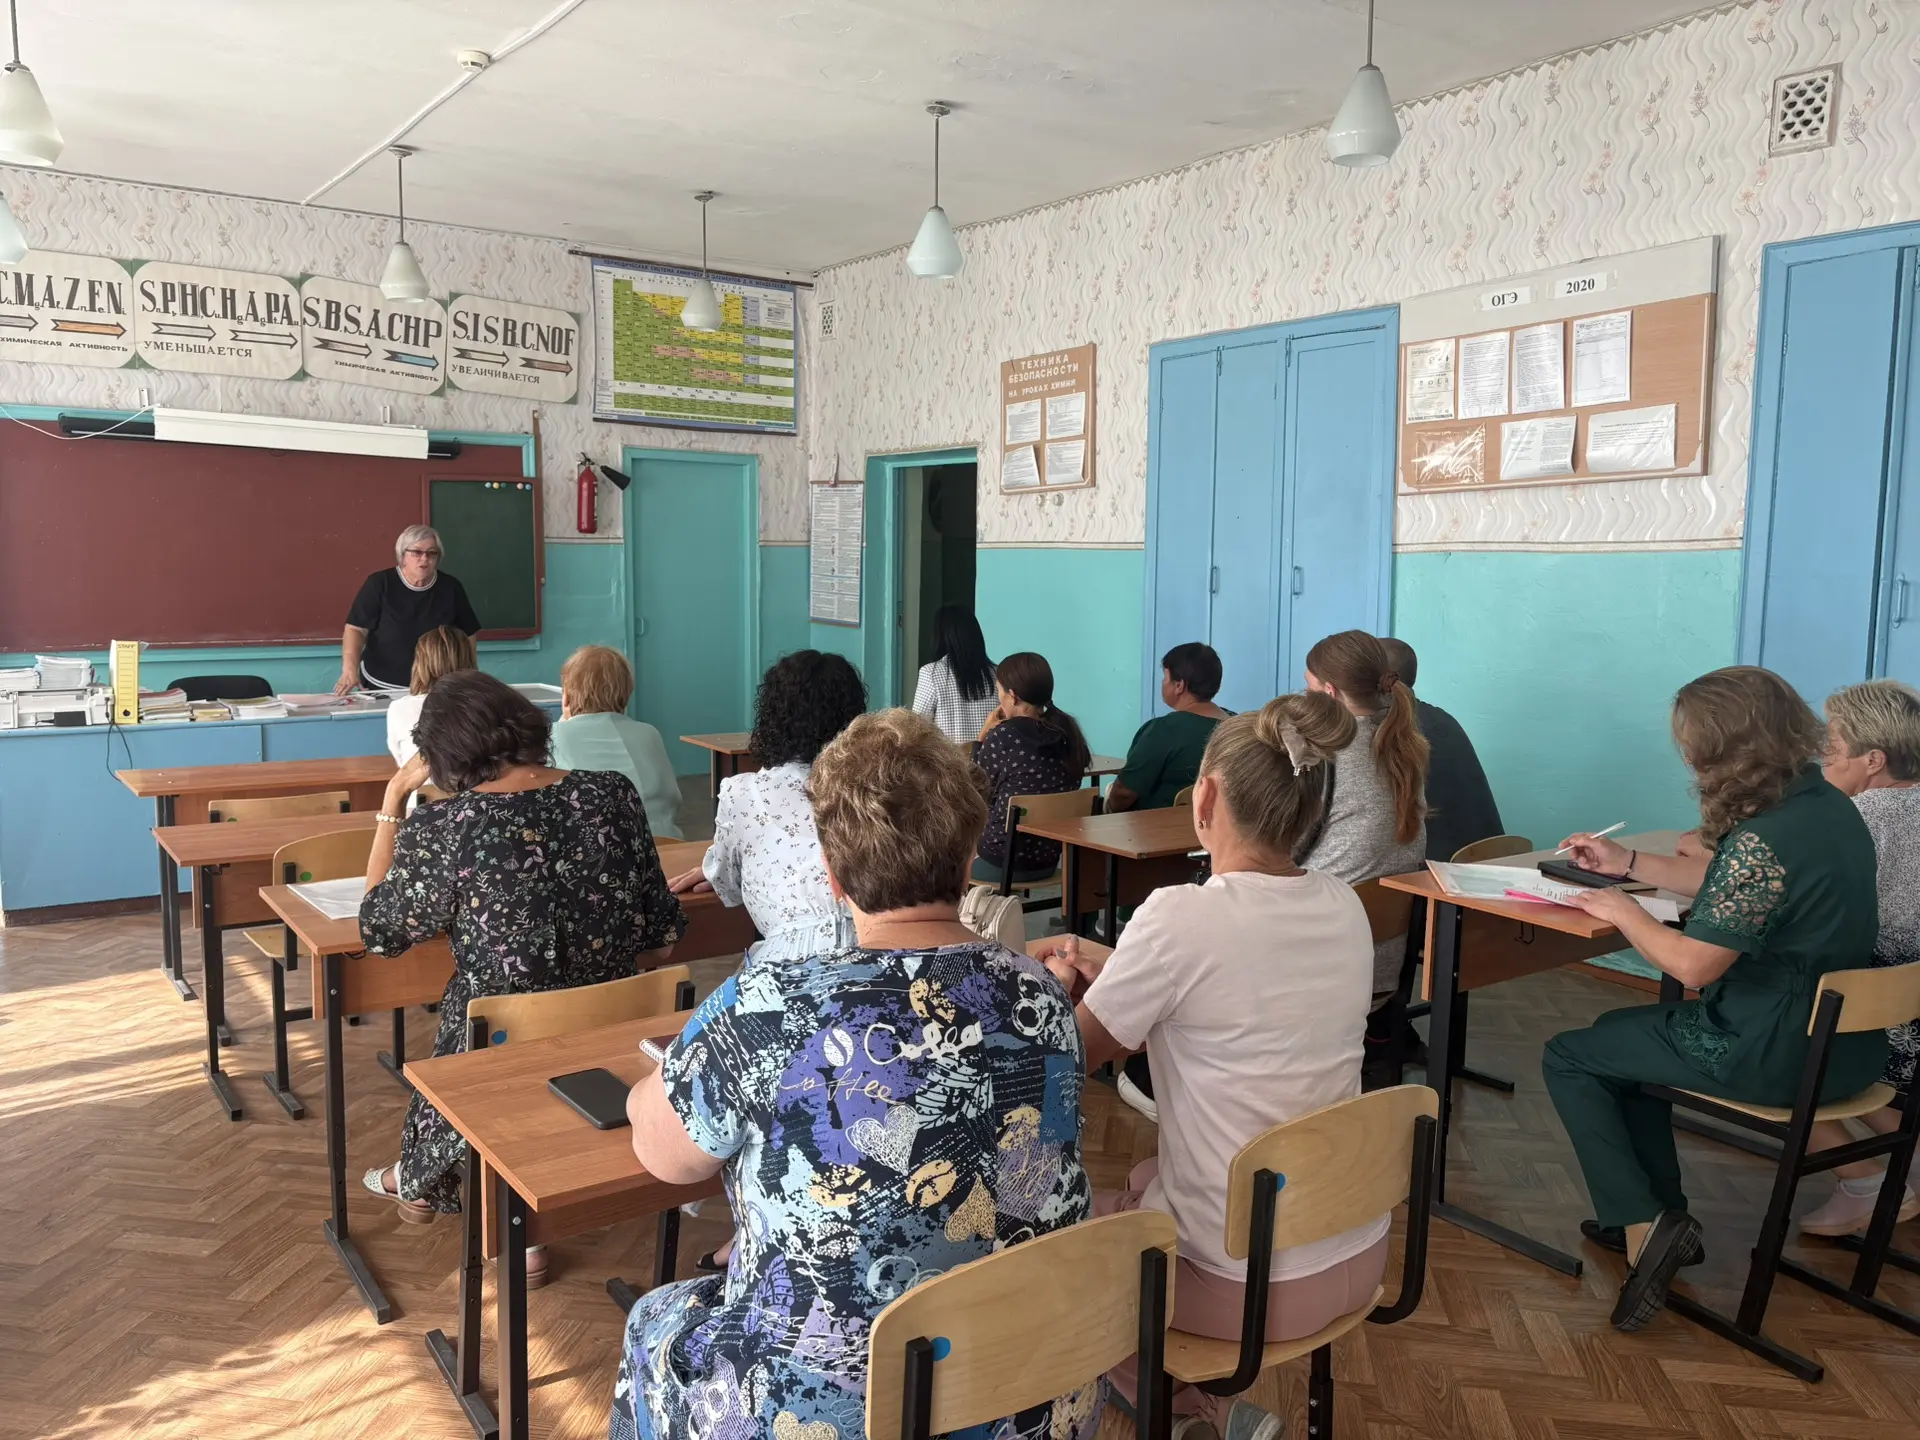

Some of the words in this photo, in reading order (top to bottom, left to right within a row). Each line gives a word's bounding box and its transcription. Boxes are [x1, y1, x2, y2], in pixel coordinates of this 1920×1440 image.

[1491, 291, 1518, 307] ОГЭ
[1566, 278, 1595, 294] 2020
[0, 336, 62, 347] ХИМИЧЕСКАЯ
[69, 342, 128, 352] АКТИВНОСТЬ
[144, 340, 252, 358] УМЕНЬШАЕТСЯ
[335, 360, 386, 373] ХИМИЧЕСКАЯ
[390, 370, 439, 382] АКТИВНОСТЬ
[1020, 354, 1069, 370] ТЕХНИКА
[452, 364, 540, 384] УВЕЛИЧИВАЕТСЯ
[1008, 362, 1079, 384] БЕЗОПАСНОСТИ
[1008, 389, 1018, 398] НА
[1021, 384, 1049, 396] УРОКАХ
[1050, 378, 1077, 390] ХИМИИ
